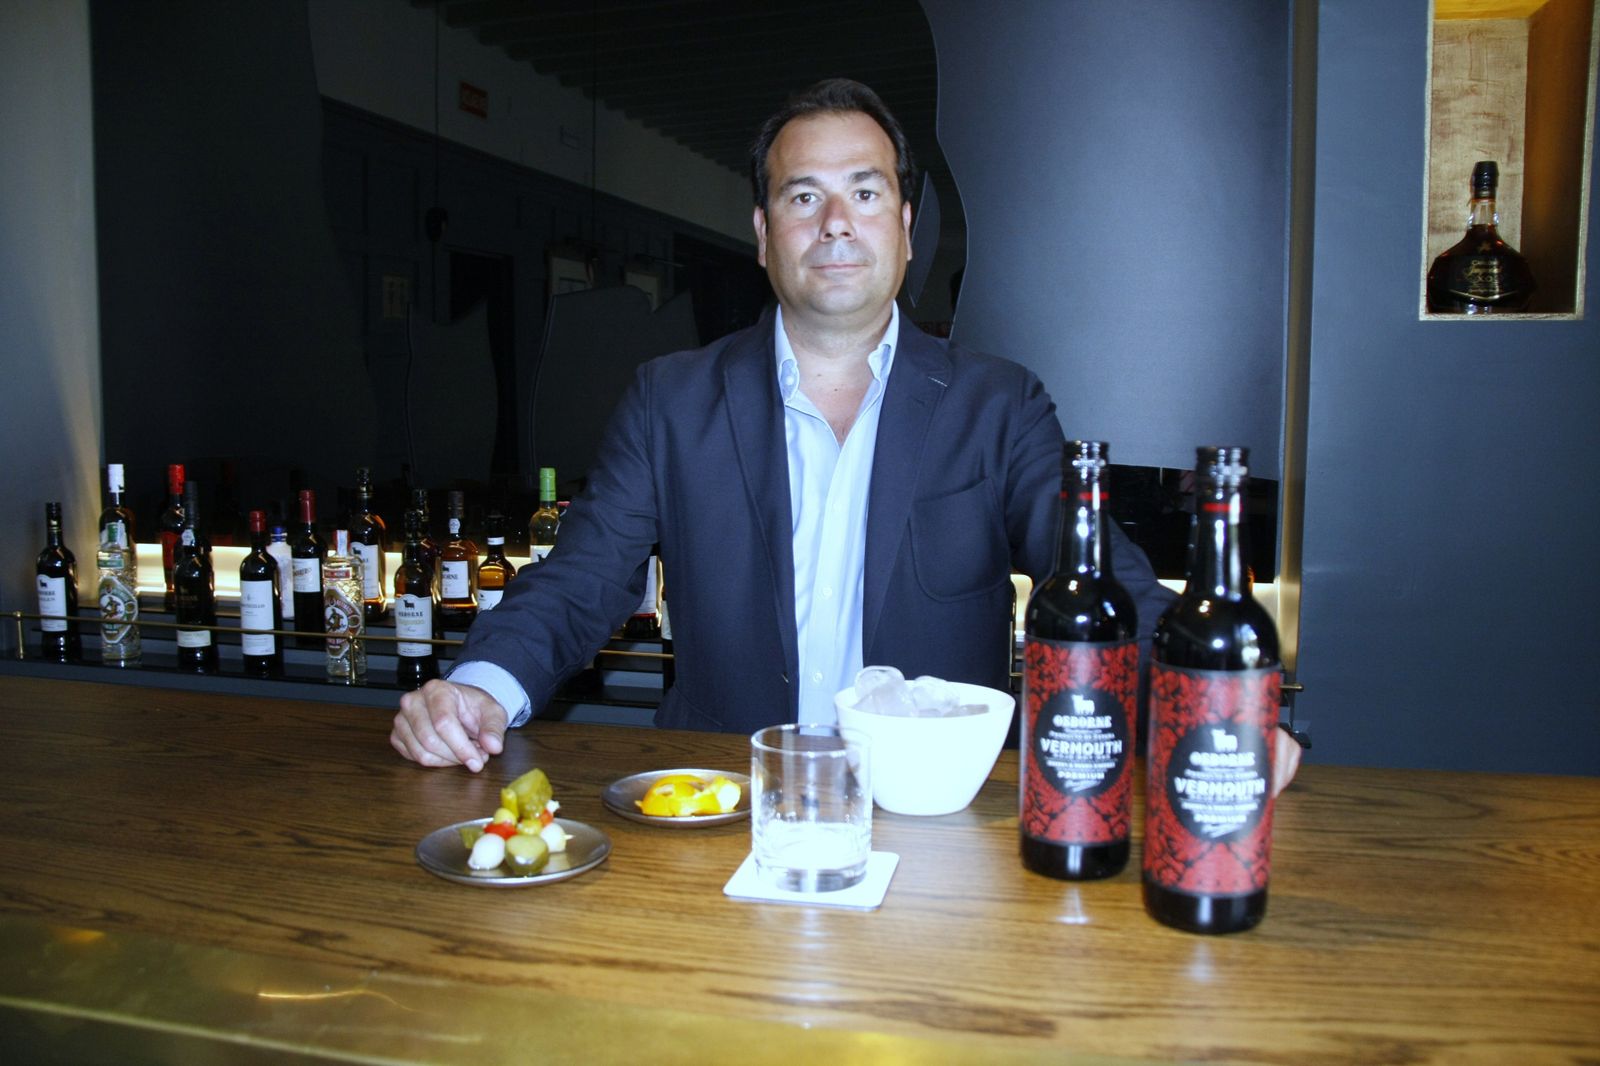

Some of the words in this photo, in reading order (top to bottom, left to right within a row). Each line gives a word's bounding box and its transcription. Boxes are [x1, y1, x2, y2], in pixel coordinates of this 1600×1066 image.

[1053, 715, 1112, 728] OSBORNE
[1040, 737, 1122, 755] VERMOUTH
[1174, 777, 1266, 797] VERMOUTH
